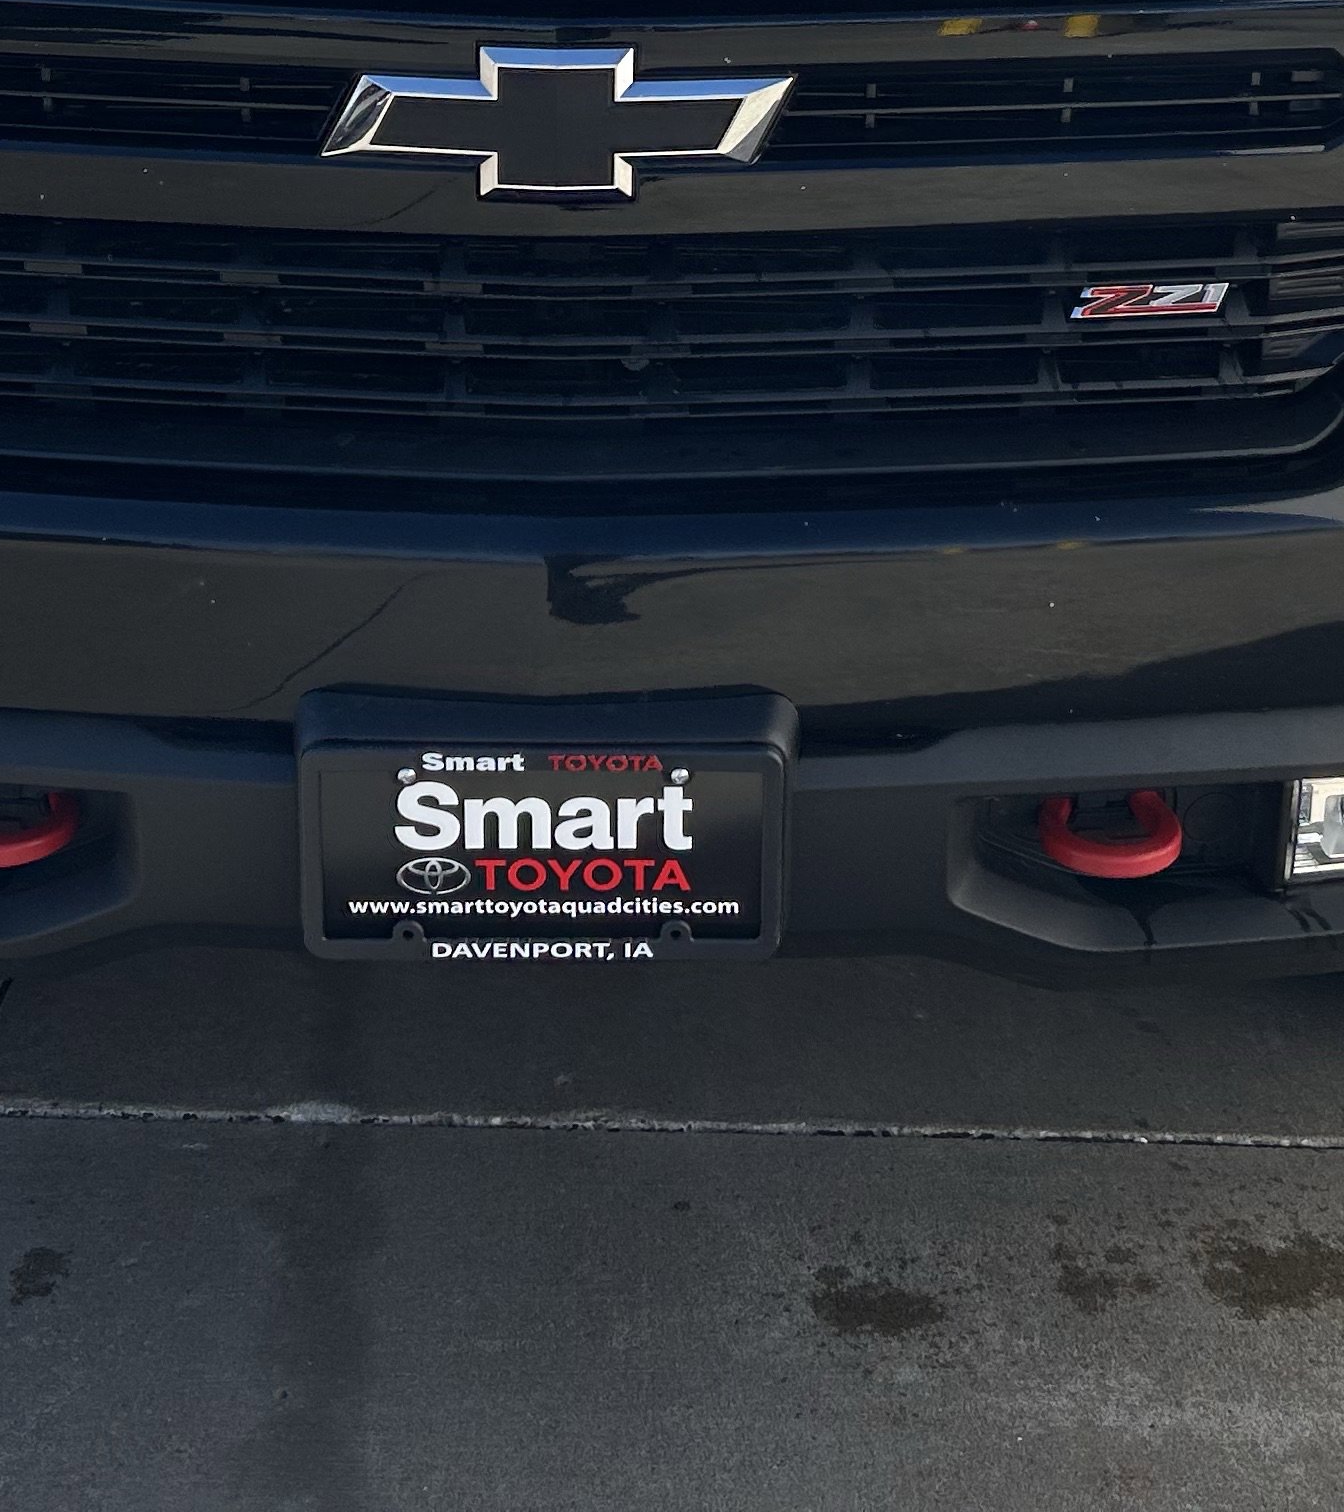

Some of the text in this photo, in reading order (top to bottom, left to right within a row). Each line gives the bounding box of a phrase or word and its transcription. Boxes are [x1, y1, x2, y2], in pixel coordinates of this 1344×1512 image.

[421, 752, 664, 773] Smart TOYOTA
[394, 781, 693, 850] Smart
[475, 858, 690, 892] TOYOTA
[348, 897, 740, 916] www.smarttoyotaquadcities.com
[431, 941, 654, 961] DAVENPORT, IA
